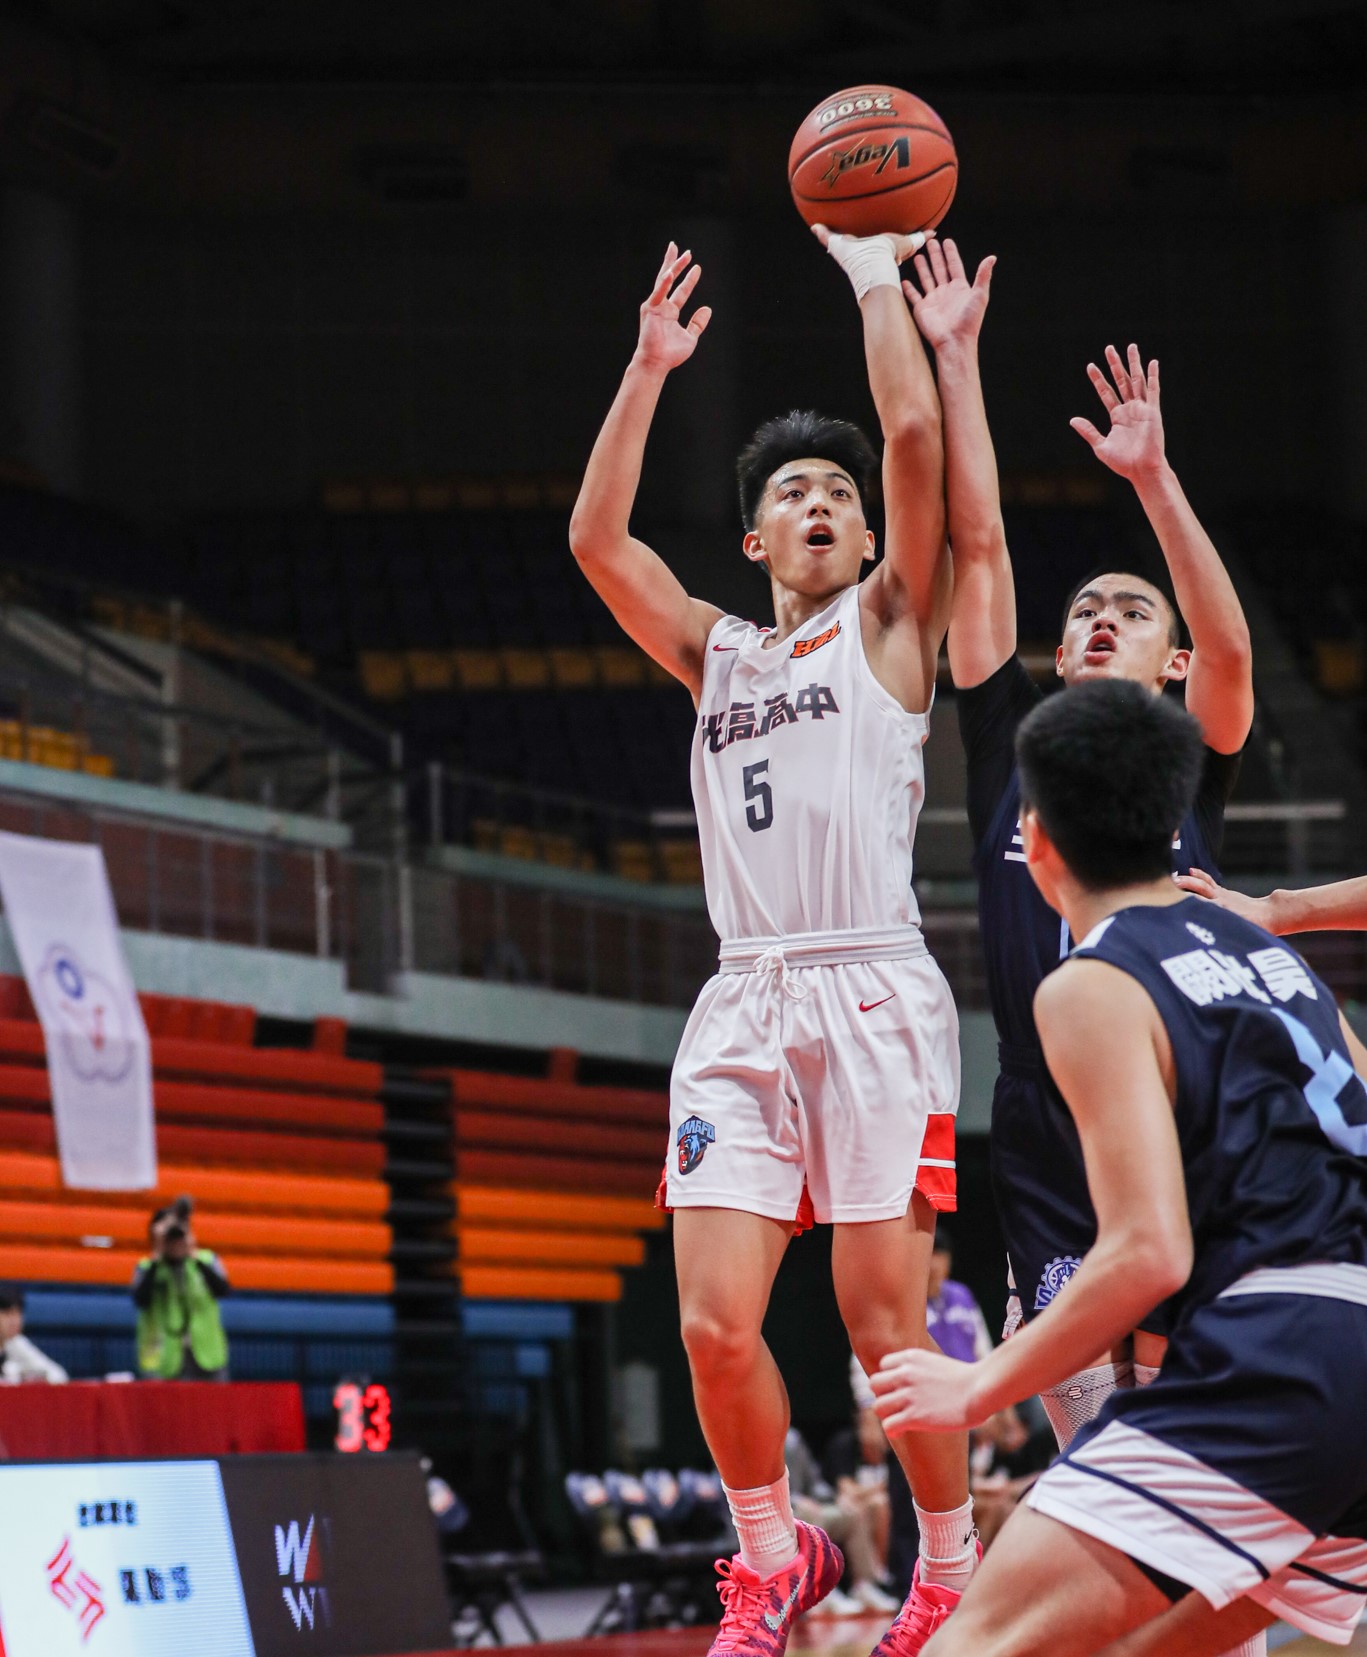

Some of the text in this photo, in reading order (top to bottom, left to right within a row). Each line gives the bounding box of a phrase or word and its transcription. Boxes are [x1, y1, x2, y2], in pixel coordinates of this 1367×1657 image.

[820, 97, 892, 124] 3600
[838, 136, 911, 177] Vega
[742, 758, 774, 833] 5
[333, 1382, 391, 1453] 33
